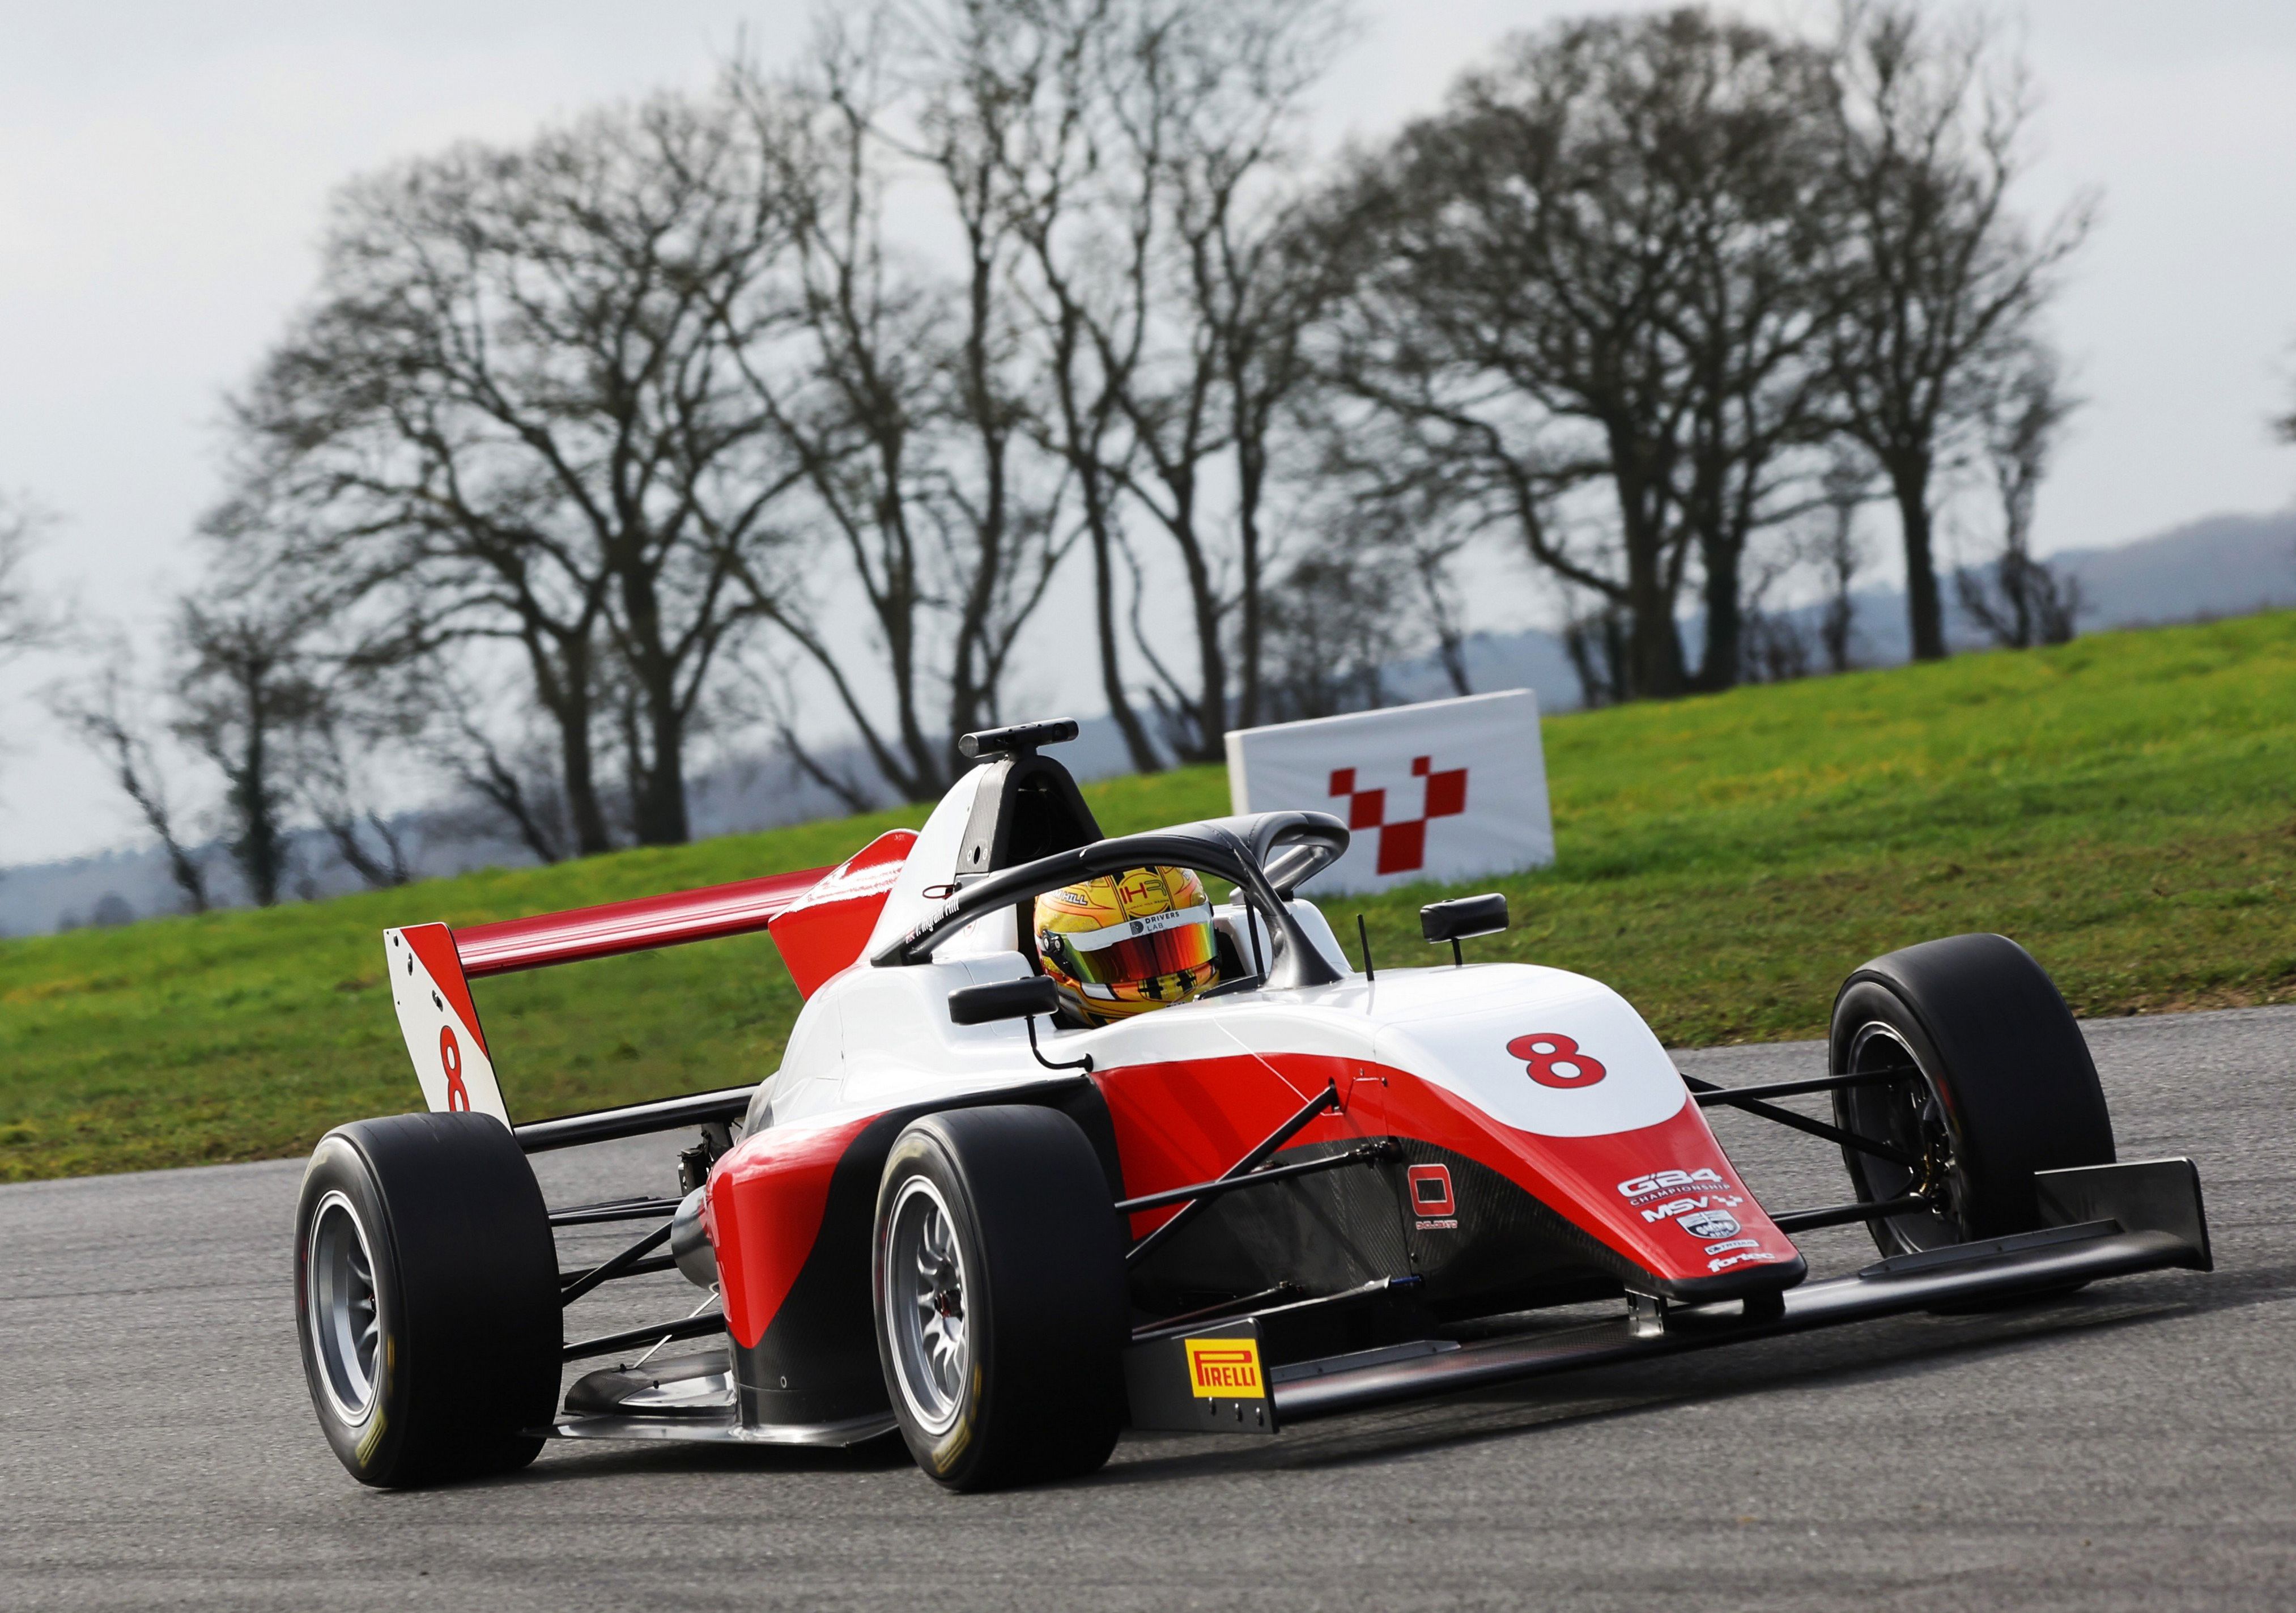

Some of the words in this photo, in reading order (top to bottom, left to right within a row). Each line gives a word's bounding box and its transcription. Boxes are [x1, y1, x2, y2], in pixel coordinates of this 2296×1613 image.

[1061, 891, 1088, 906] HILL
[1145, 911, 1180, 924] DRIVERS
[1147, 923, 1163, 932] LAB
[440, 1025, 470, 1112] 8
[1507, 1033, 1607, 1089] 8
[1617, 1168, 1723, 1198] GB4
[1630, 1183, 1730, 1206] CHAMPIONSHIP
[1641, 1196, 1708, 1223] MSV
[1193, 1351, 1256, 1386] PIRELLI
